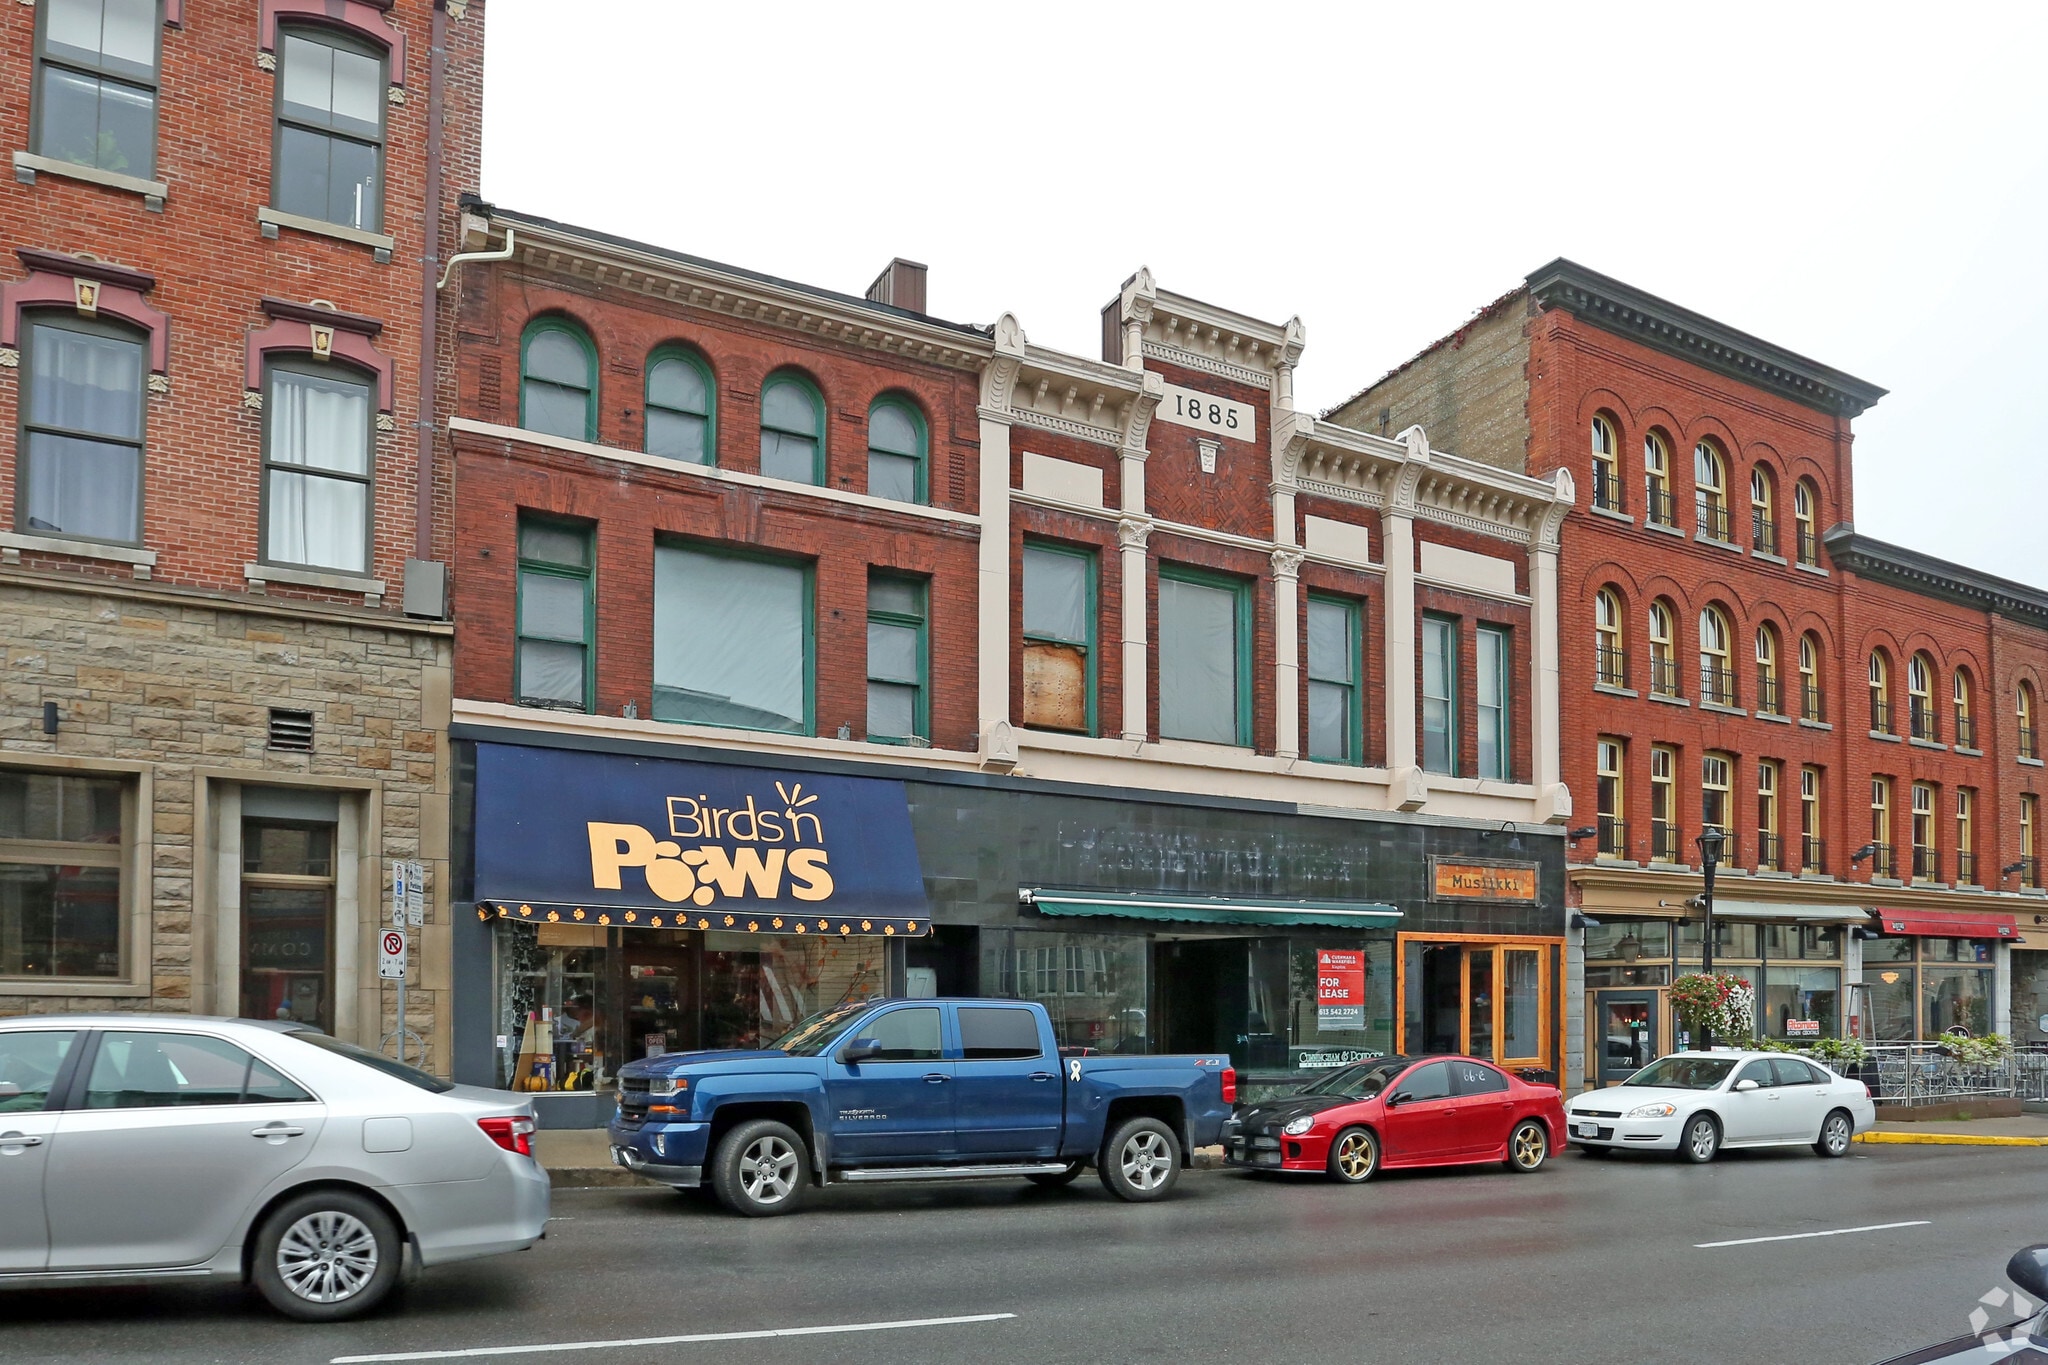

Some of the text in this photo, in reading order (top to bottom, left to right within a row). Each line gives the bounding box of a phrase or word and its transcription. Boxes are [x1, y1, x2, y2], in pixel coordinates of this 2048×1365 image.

[1176, 395, 1238, 429] 1885
[1453, 875, 1519, 891] Musiikki
[1319, 977, 1340, 987] FOR
[1319, 989, 1349, 998] LEASE
[1341, 1051, 1349, 1062] &
[1624, 1057, 1633, 1065] 71
